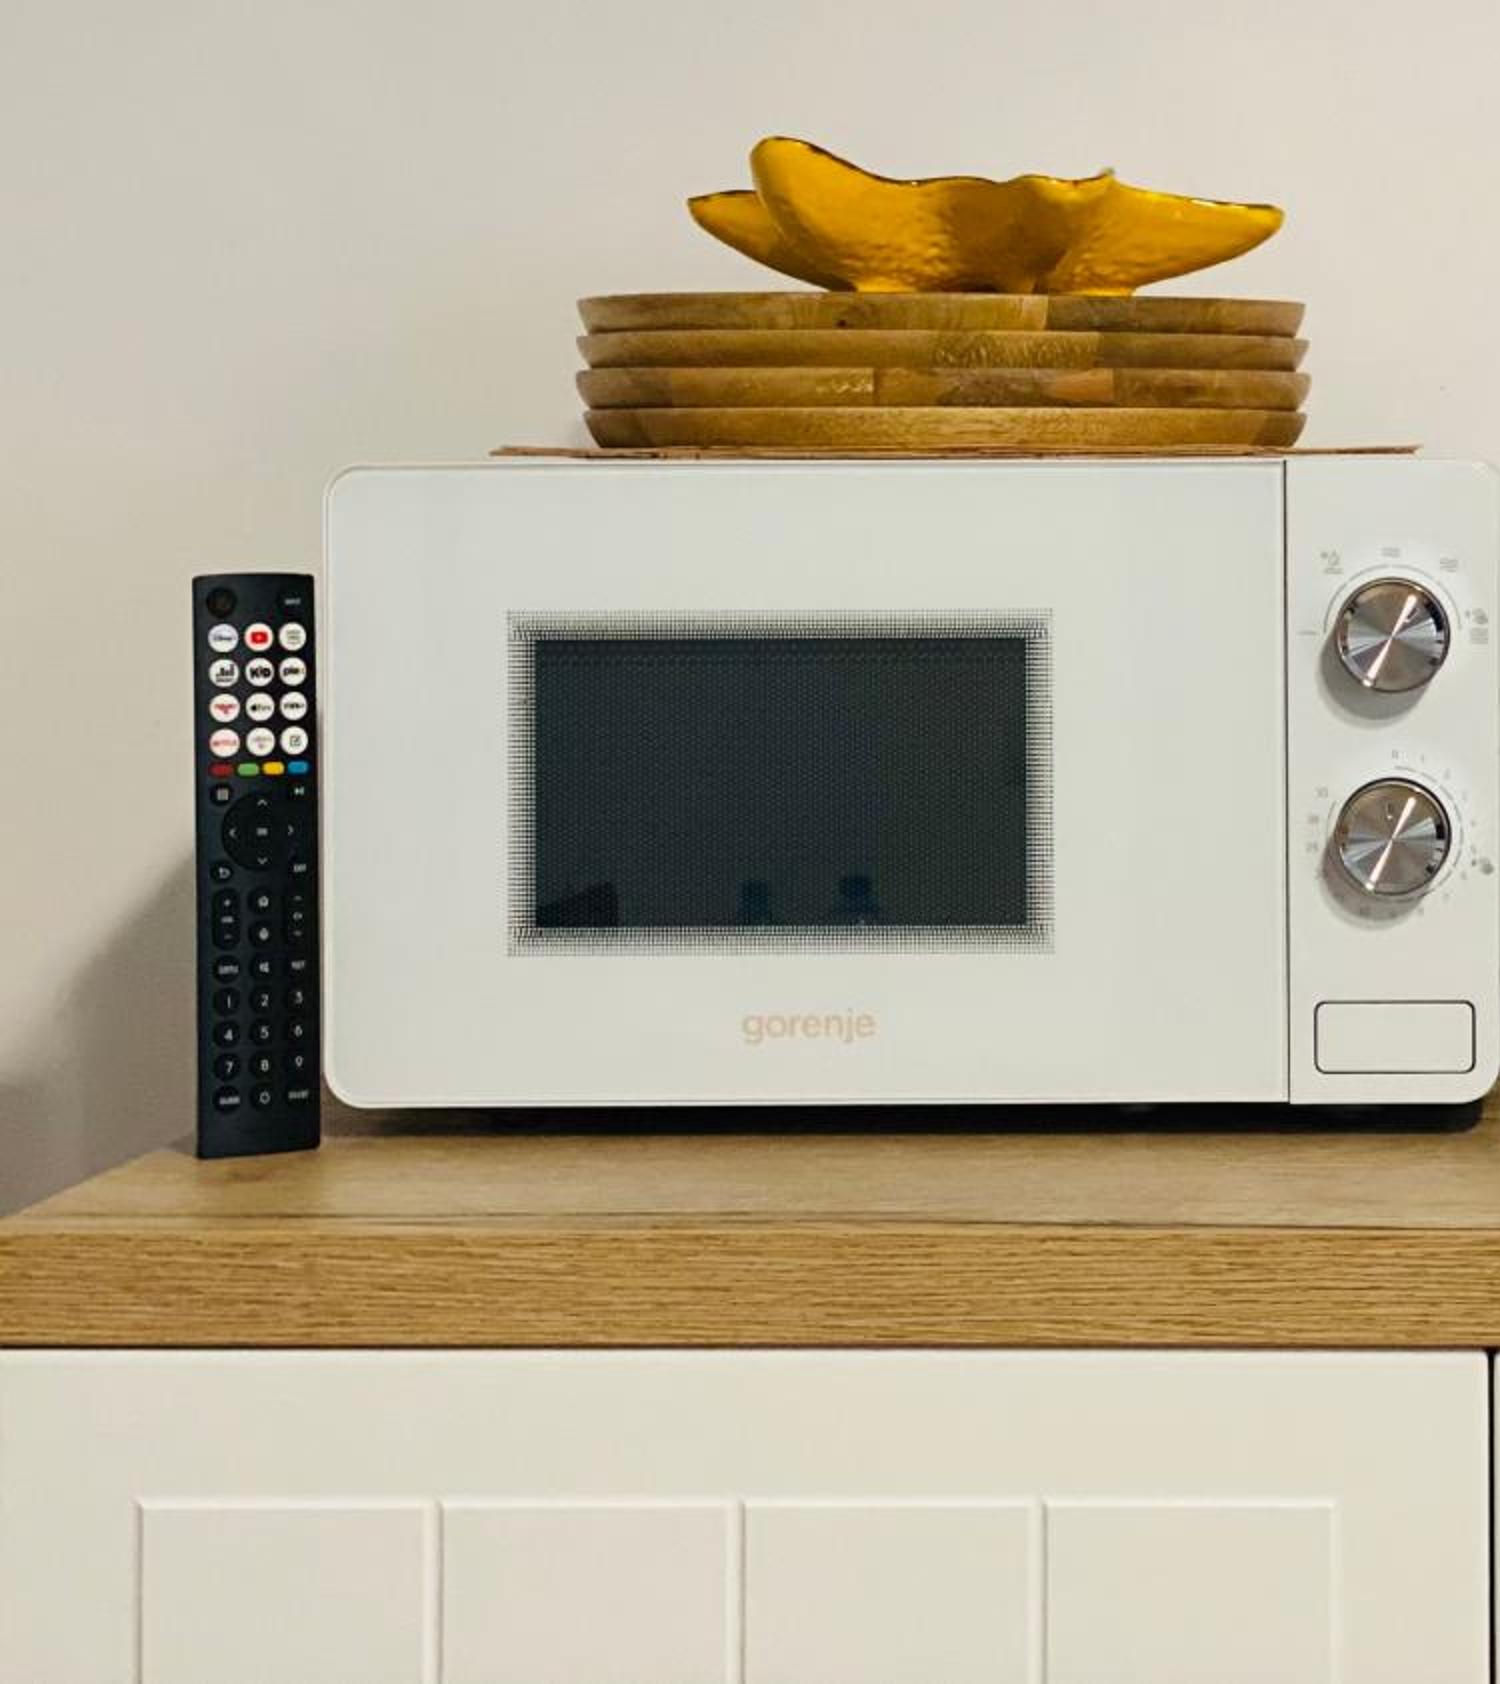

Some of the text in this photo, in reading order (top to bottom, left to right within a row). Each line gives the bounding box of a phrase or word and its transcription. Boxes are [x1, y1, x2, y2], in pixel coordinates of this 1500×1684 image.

[260, 994, 270, 1007] 2
[223, 1029, 233, 1041] 4
[260, 1026, 270, 1039] 5
[742, 1008, 876, 1047] gorenje
[225, 1061, 234, 1073] 7
[260, 1059, 270, 1072] 8
